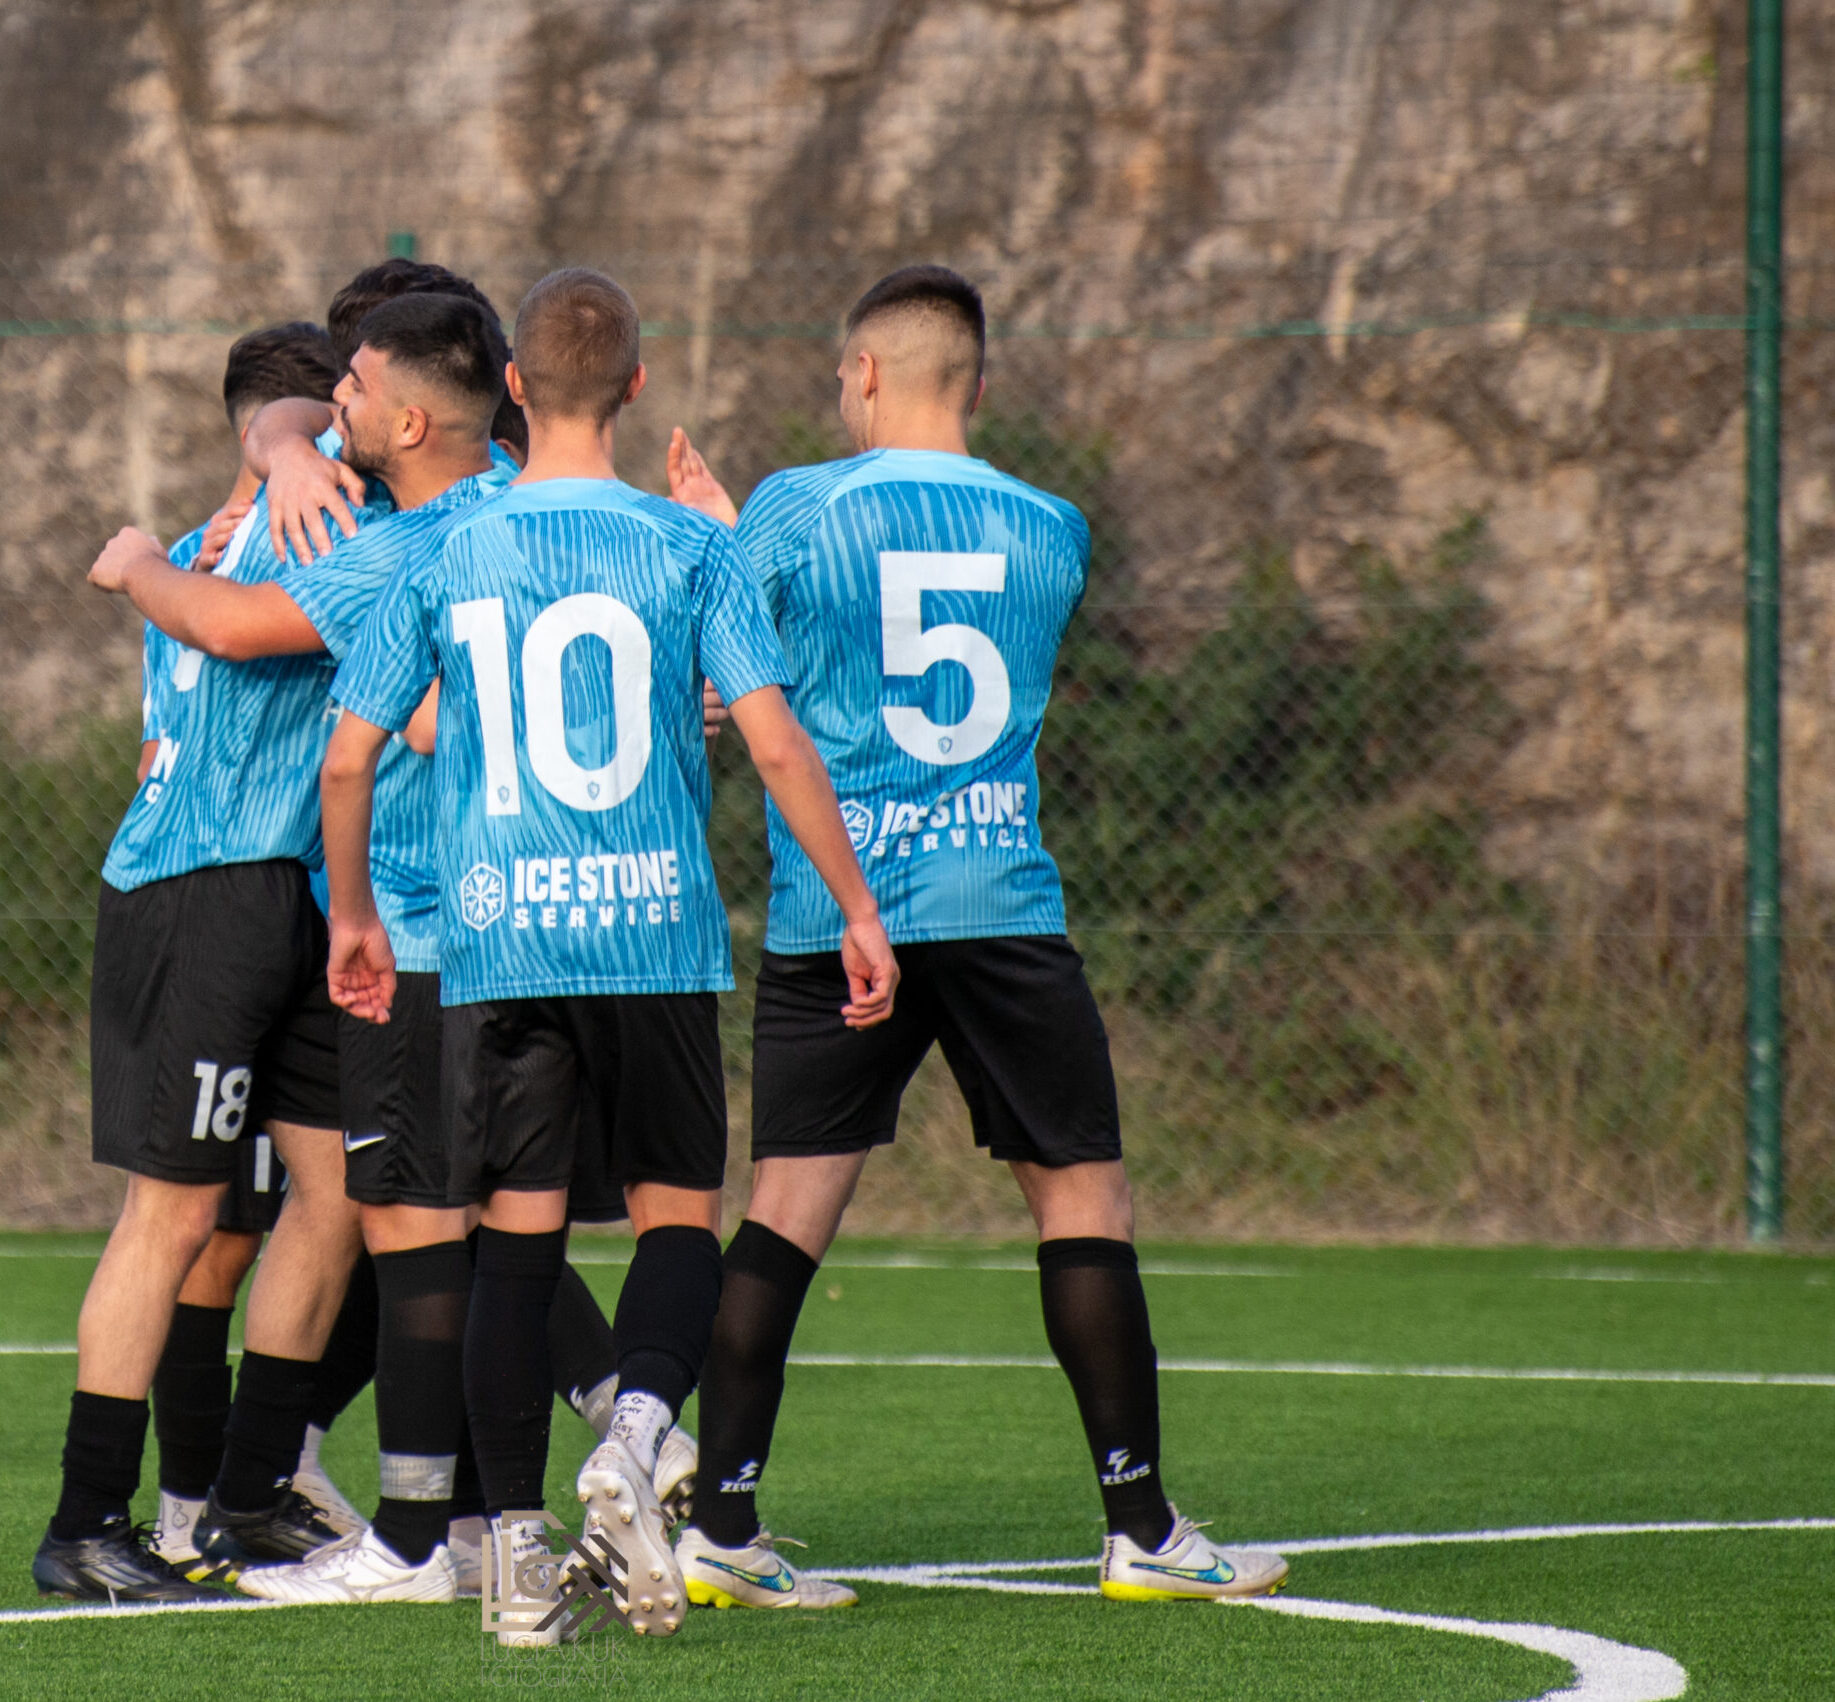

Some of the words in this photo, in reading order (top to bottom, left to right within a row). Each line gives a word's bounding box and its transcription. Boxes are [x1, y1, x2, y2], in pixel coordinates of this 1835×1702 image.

[879, 551, 1011, 766] 5
[451, 592, 652, 816] 10
[878, 800, 930, 839] ICE
[929, 782, 1027, 829] STONE
[870, 829, 1029, 857] SERVICE
[514, 857, 571, 903] ICE
[577, 850, 680, 900] STONE
[514, 901, 681, 929] SERVICE
[191, 1061, 252, 1142] 18
[1101, 1463, 1151, 1485] ZEUS
